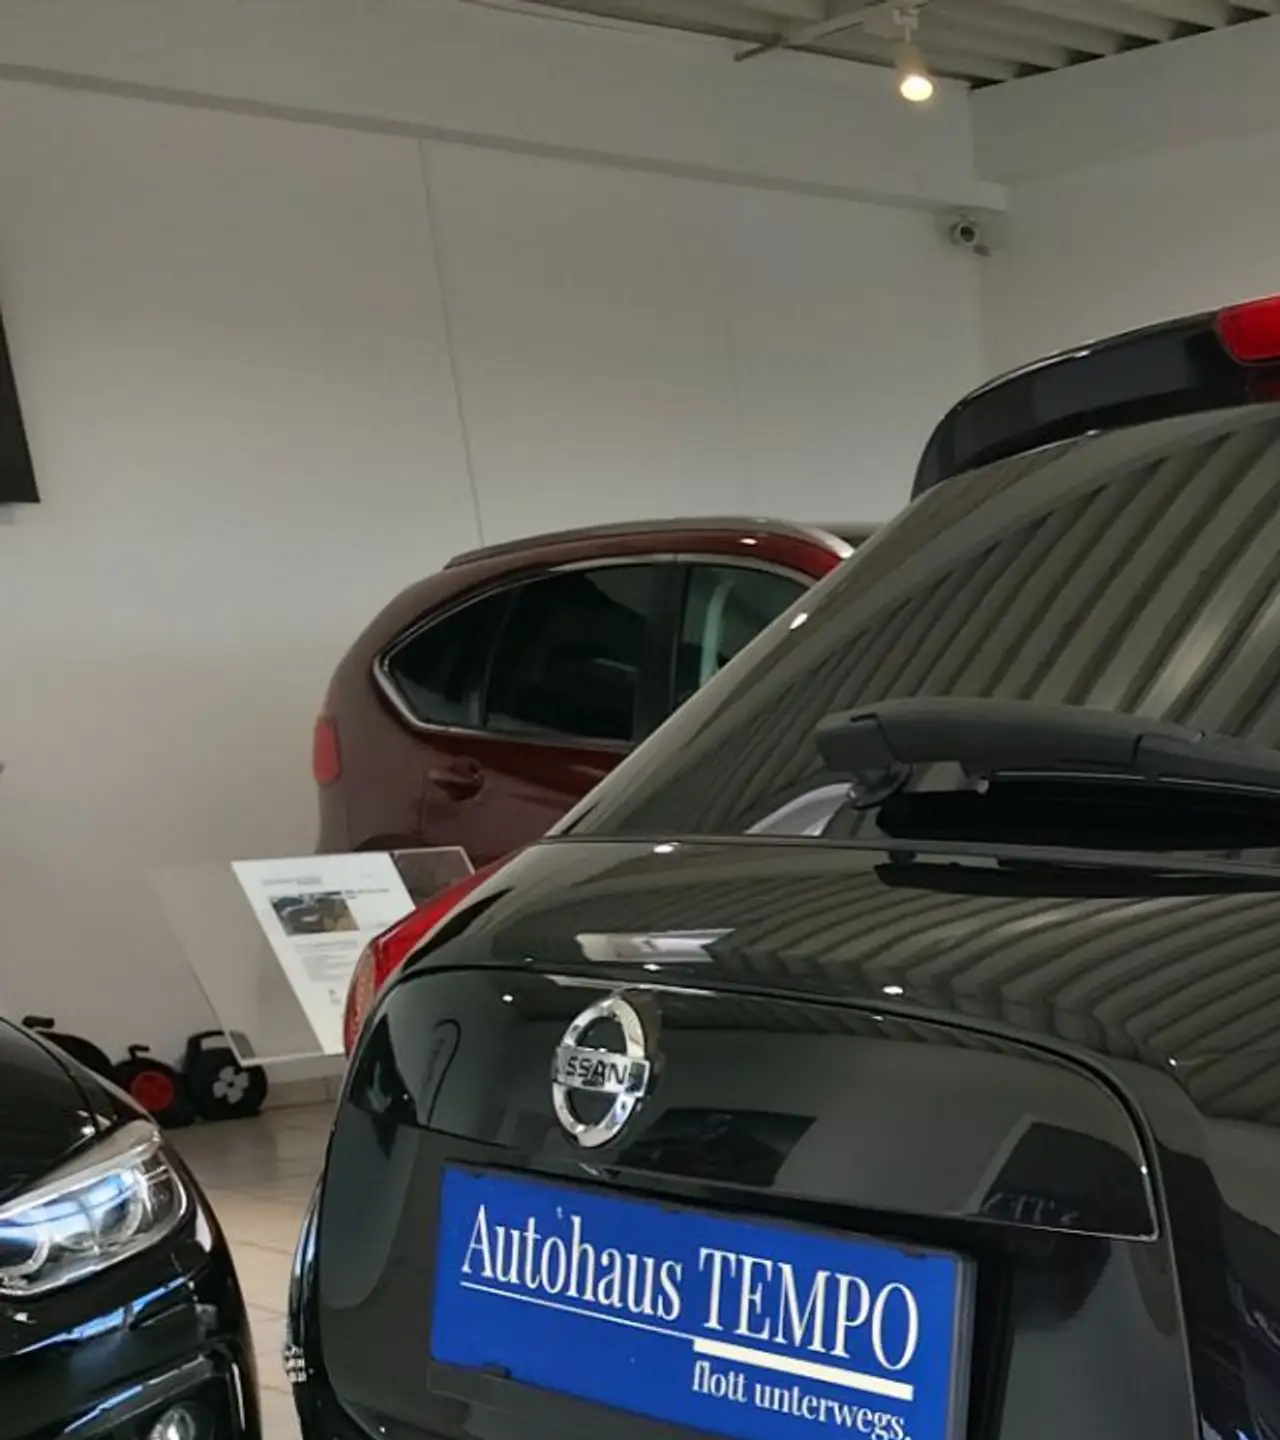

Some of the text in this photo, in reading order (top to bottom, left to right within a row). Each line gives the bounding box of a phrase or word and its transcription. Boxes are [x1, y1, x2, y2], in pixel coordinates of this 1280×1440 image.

[461, 1204, 919, 1371] Autohaus TEMPO
[692, 1360, 748, 1402] flott
